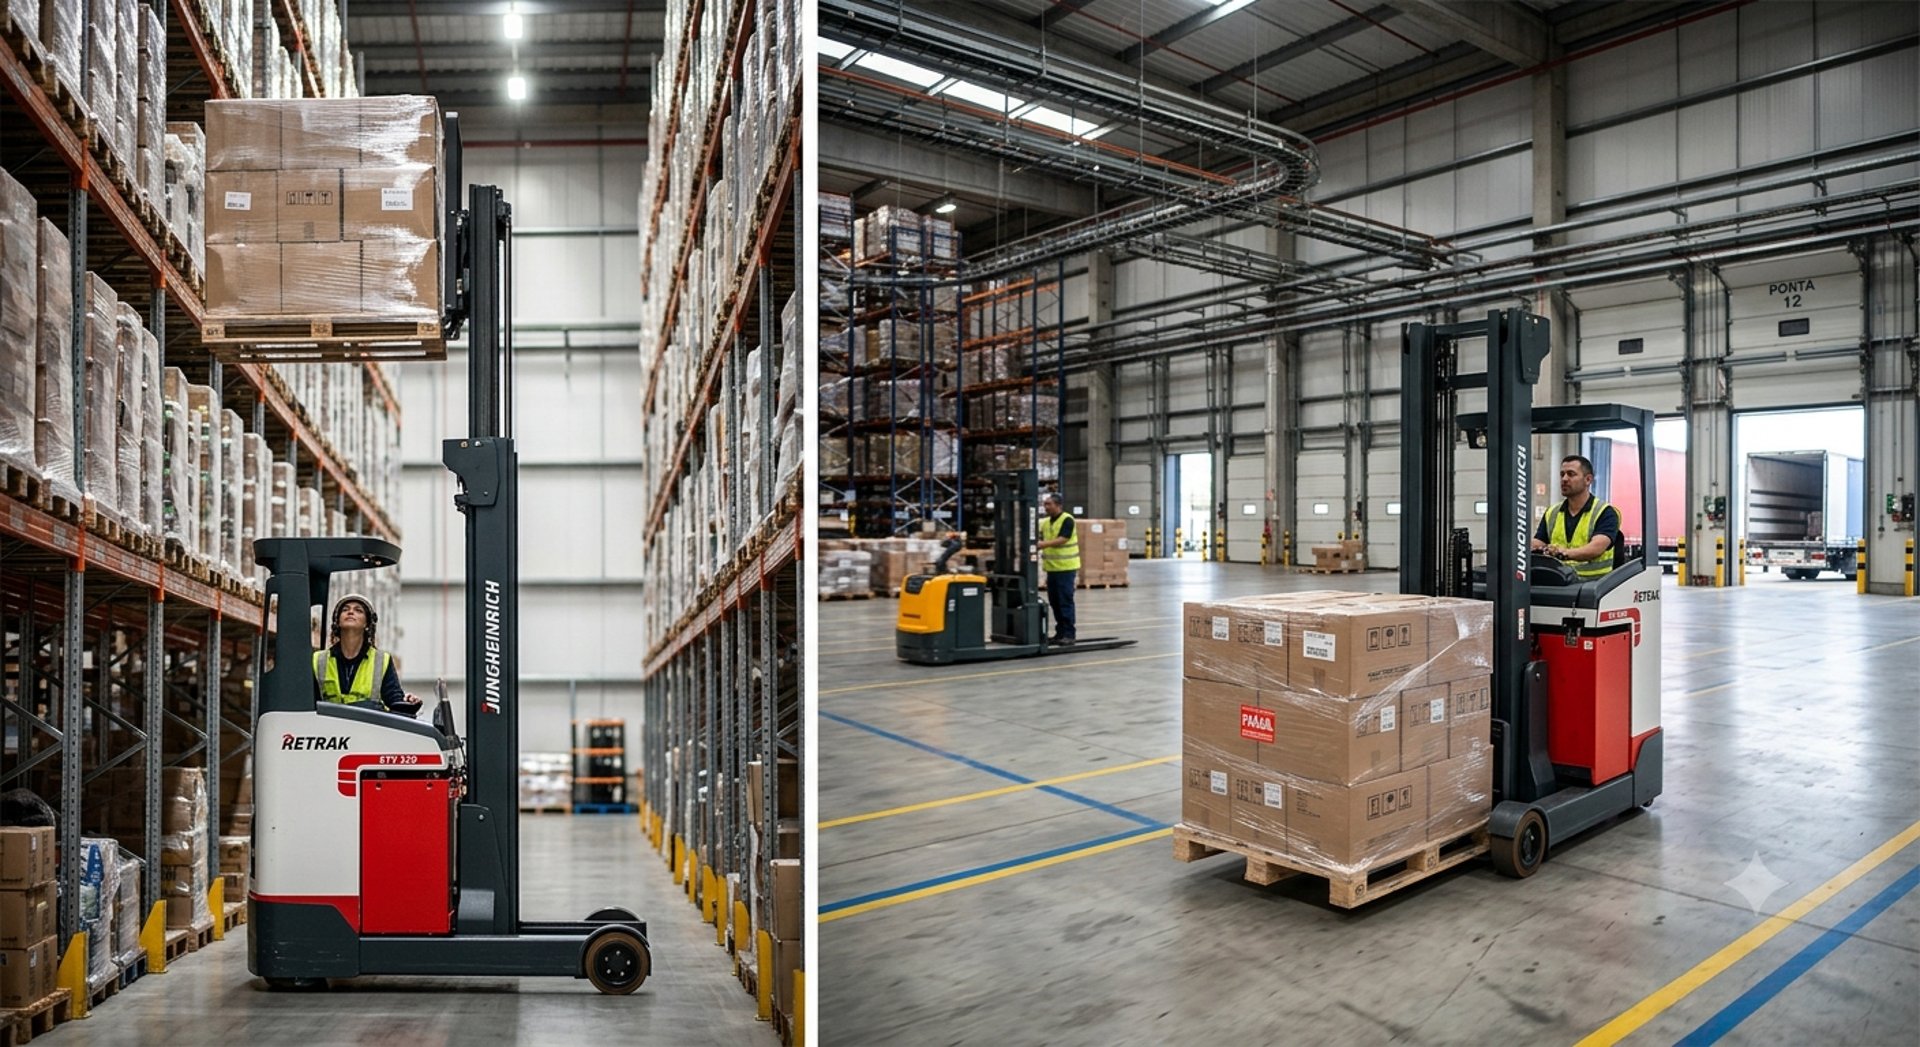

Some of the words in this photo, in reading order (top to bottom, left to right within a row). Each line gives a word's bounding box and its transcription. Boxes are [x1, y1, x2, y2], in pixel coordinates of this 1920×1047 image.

[1769, 279, 1815, 295] PONTA
[1784, 294, 1802, 308] 12
[481, 580, 500, 714] JUNGHEINRICH
[282, 734, 351, 750] RETRAK
